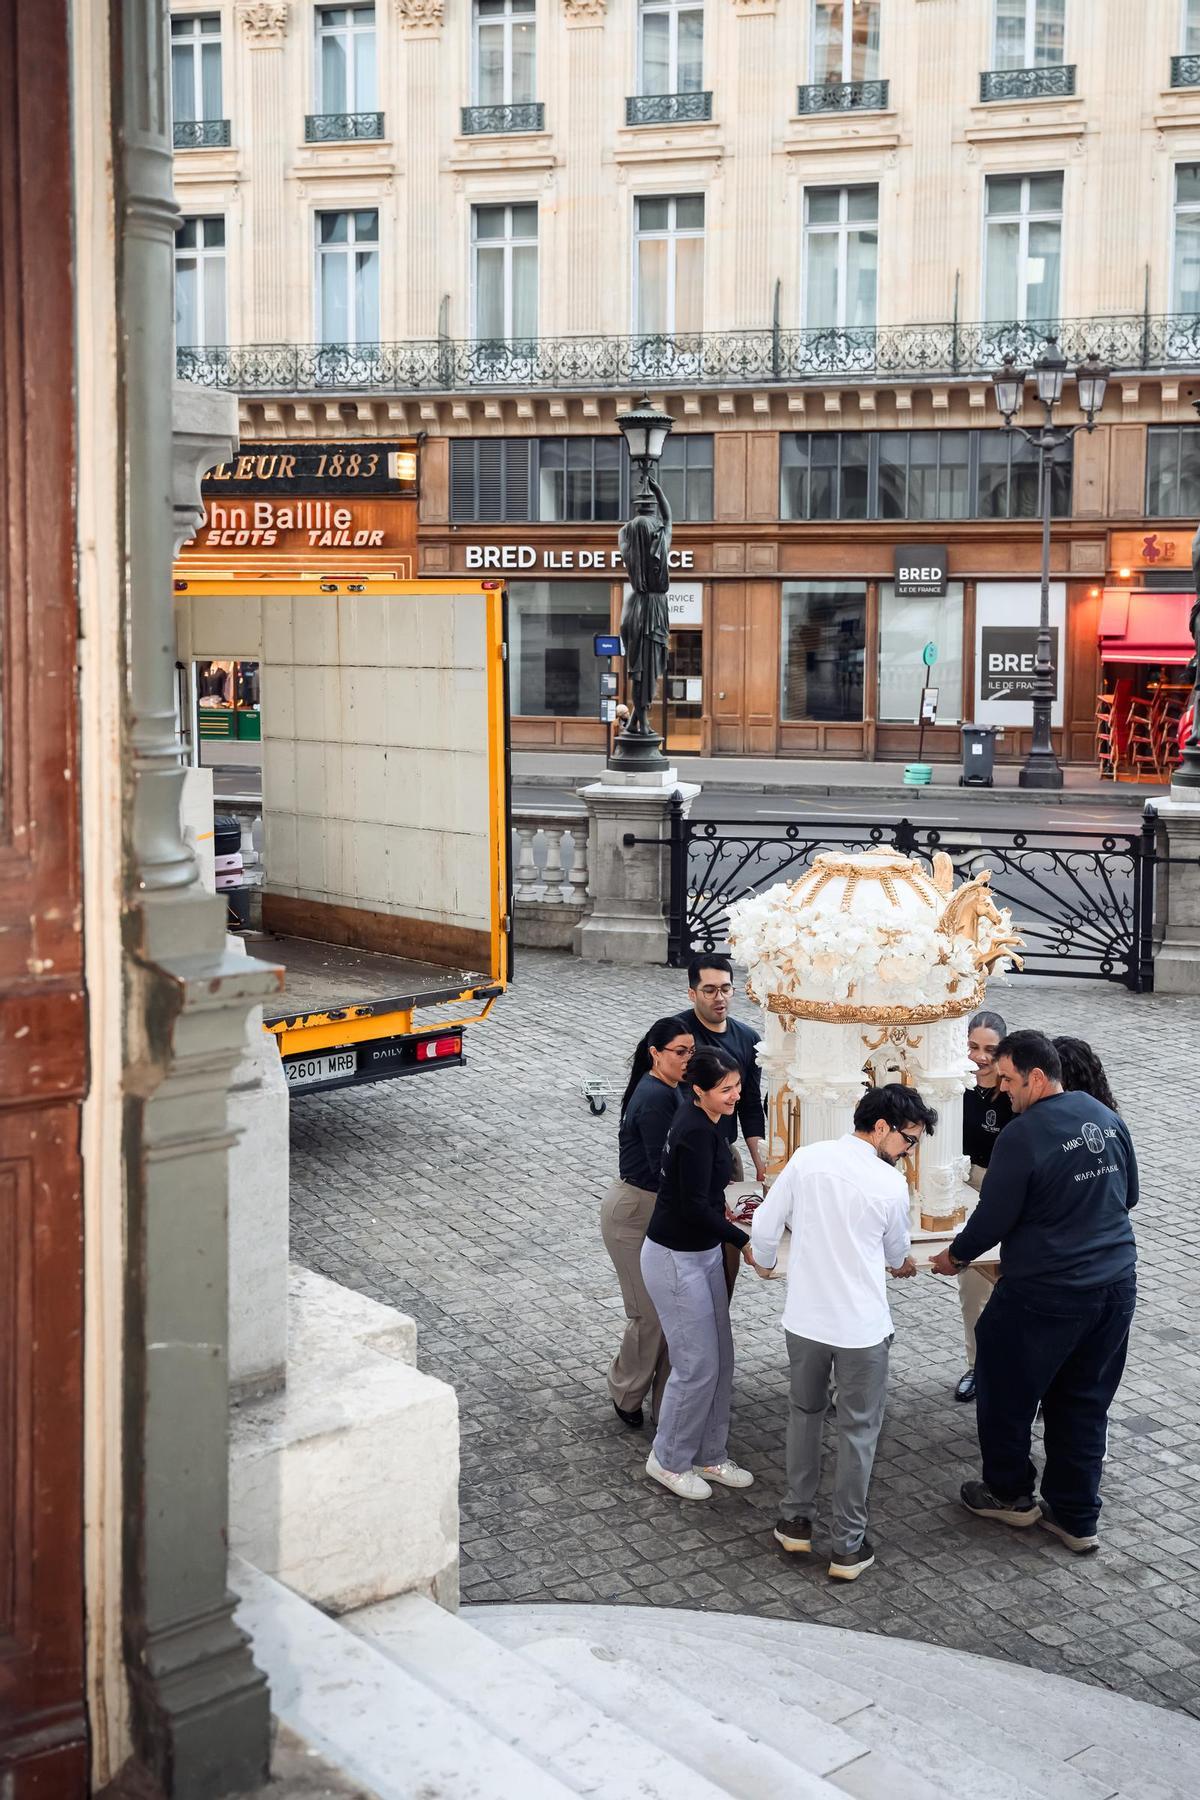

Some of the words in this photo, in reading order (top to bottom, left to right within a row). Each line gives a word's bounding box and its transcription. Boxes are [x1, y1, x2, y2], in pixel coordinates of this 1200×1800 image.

[203, 455, 297, 480] LEUR
[313, 453, 379, 478] 1883
[255, 503, 352, 529] Baillie
[206, 530, 277, 546] SCOTS
[308, 530, 384, 546] TAILOR
[465, 546, 537, 568] BRED
[543, 550, 574, 568] ILE
[579, 550, 605, 568] DE
[611, 550, 694, 568] FCE
[899, 567, 942, 580] BRED
[667, 594, 695, 602] RVICE
[988, 654, 1051, 672] BRE
[988, 681, 1001, 689] ILE
[1003, 681, 1014, 689] DE
[373, 1047, 403, 1060] DAILY
[289, 1060, 323, 1080] 2601
[328, 1054, 354, 1072] MRB
[1073, 1170, 1096, 1182] WAFA
